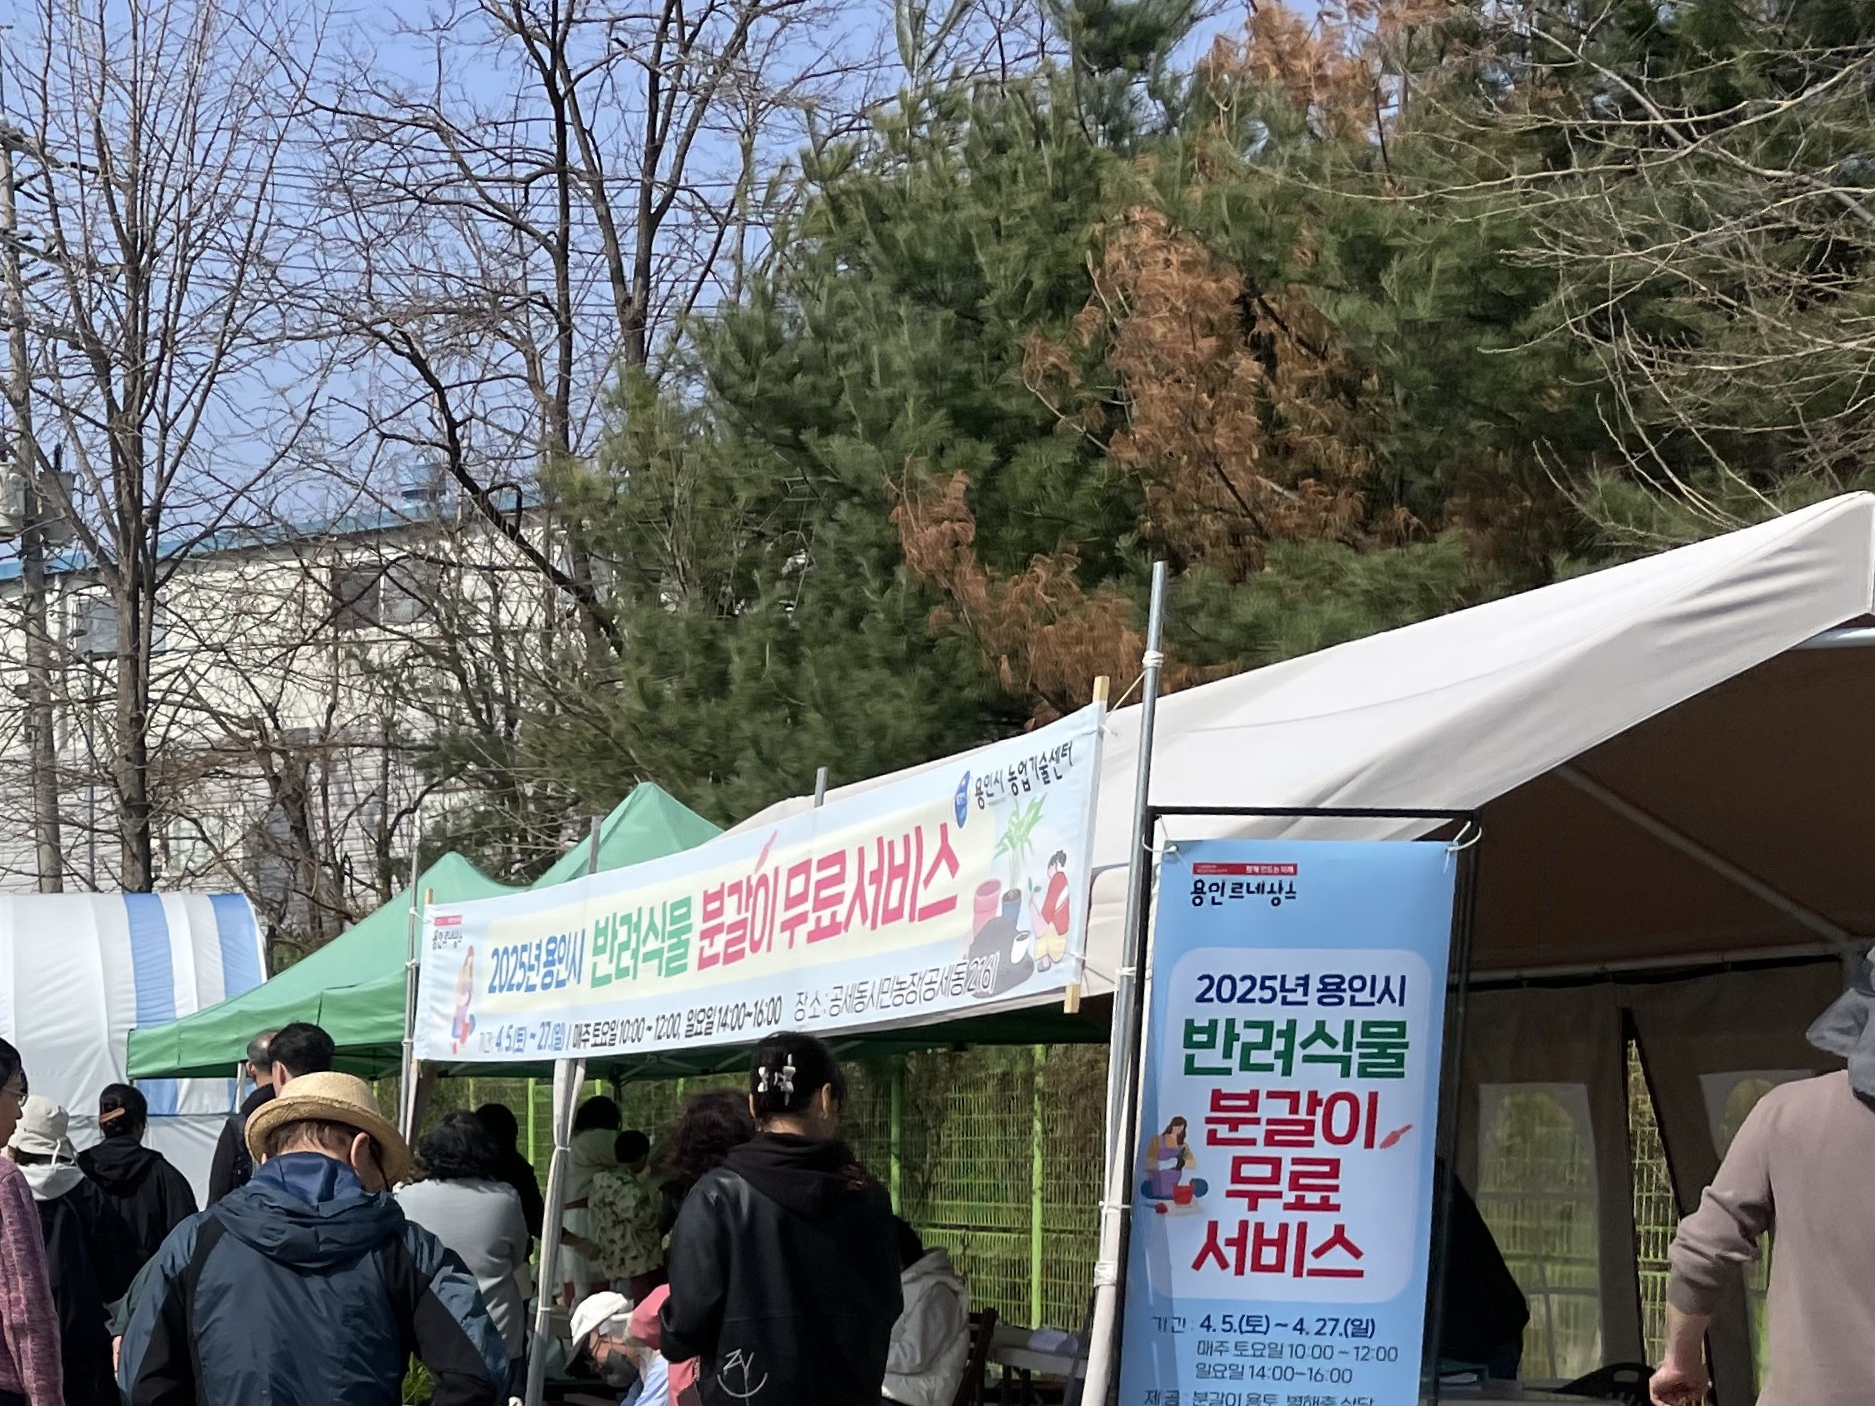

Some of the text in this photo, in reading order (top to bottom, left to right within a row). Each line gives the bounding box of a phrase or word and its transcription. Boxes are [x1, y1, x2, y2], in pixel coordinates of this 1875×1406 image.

[974, 740, 1074, 810] 용인시 농업기술센터
[487, 939, 543, 994] 2025년
[540, 928, 586, 992] 용인시
[590, 895, 693, 990] 반려식물
[696, 865, 780, 972] 분갈이
[1195, 973, 1407, 1008] 2025년 용인시
[1182, 1017, 1410, 1079] 반려식물
[1204, 1088, 1379, 1149] 분갈이
[1224, 1155, 1342, 1212] 무료
[1191, 1219, 1365, 1278] 서비스
[1195, 1363, 1245, 1381] 일요일
[1196, 1340, 1230, 1358] 매주
[1233, 1341, 1284, 1360] 토요일
[1288, 1343, 1334, 1361] 10:00
[1354, 1345, 1399, 1363] 12:00
